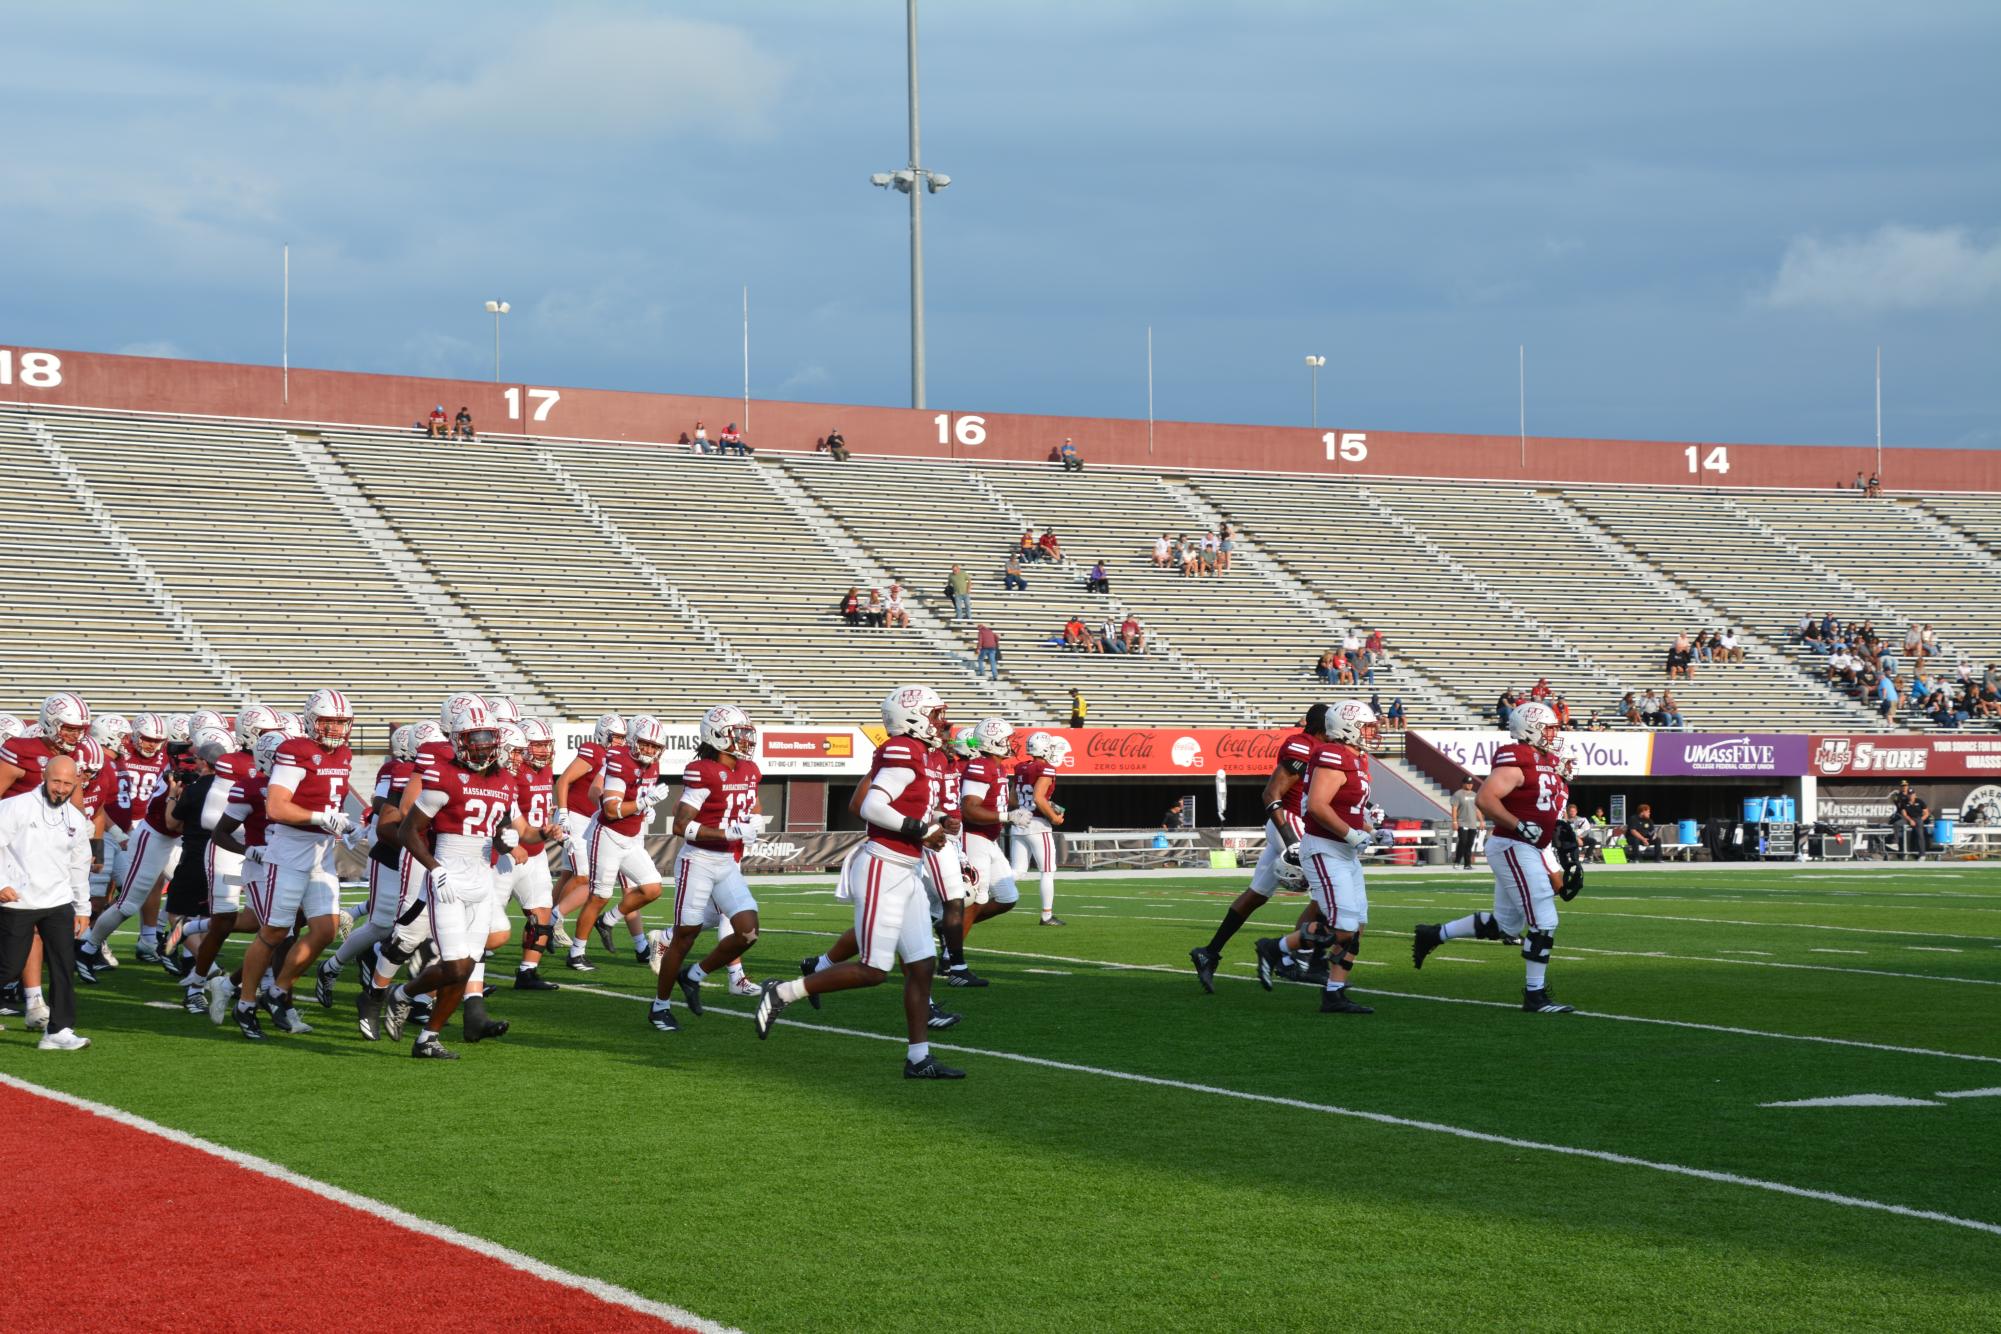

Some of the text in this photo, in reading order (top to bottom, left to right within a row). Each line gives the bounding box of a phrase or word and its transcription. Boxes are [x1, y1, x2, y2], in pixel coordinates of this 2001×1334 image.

[0, 350, 62, 387] 18
[504, 387, 560, 421] 17
[934, 414, 986, 446] 16
[1322, 432, 1368, 462] 15
[1684, 445, 1730, 474] 14
[768, 741, 793, 750] Milton
[793, 741, 817, 750] Rents
[1086, 731, 1156, 758] Coca-Cola
[1216, 732, 1280, 758] Coca-Cola
[1581, 742, 1629, 766] You.
[462, 798, 507, 837] 20
[743, 843, 795, 857] LAGSHIP
